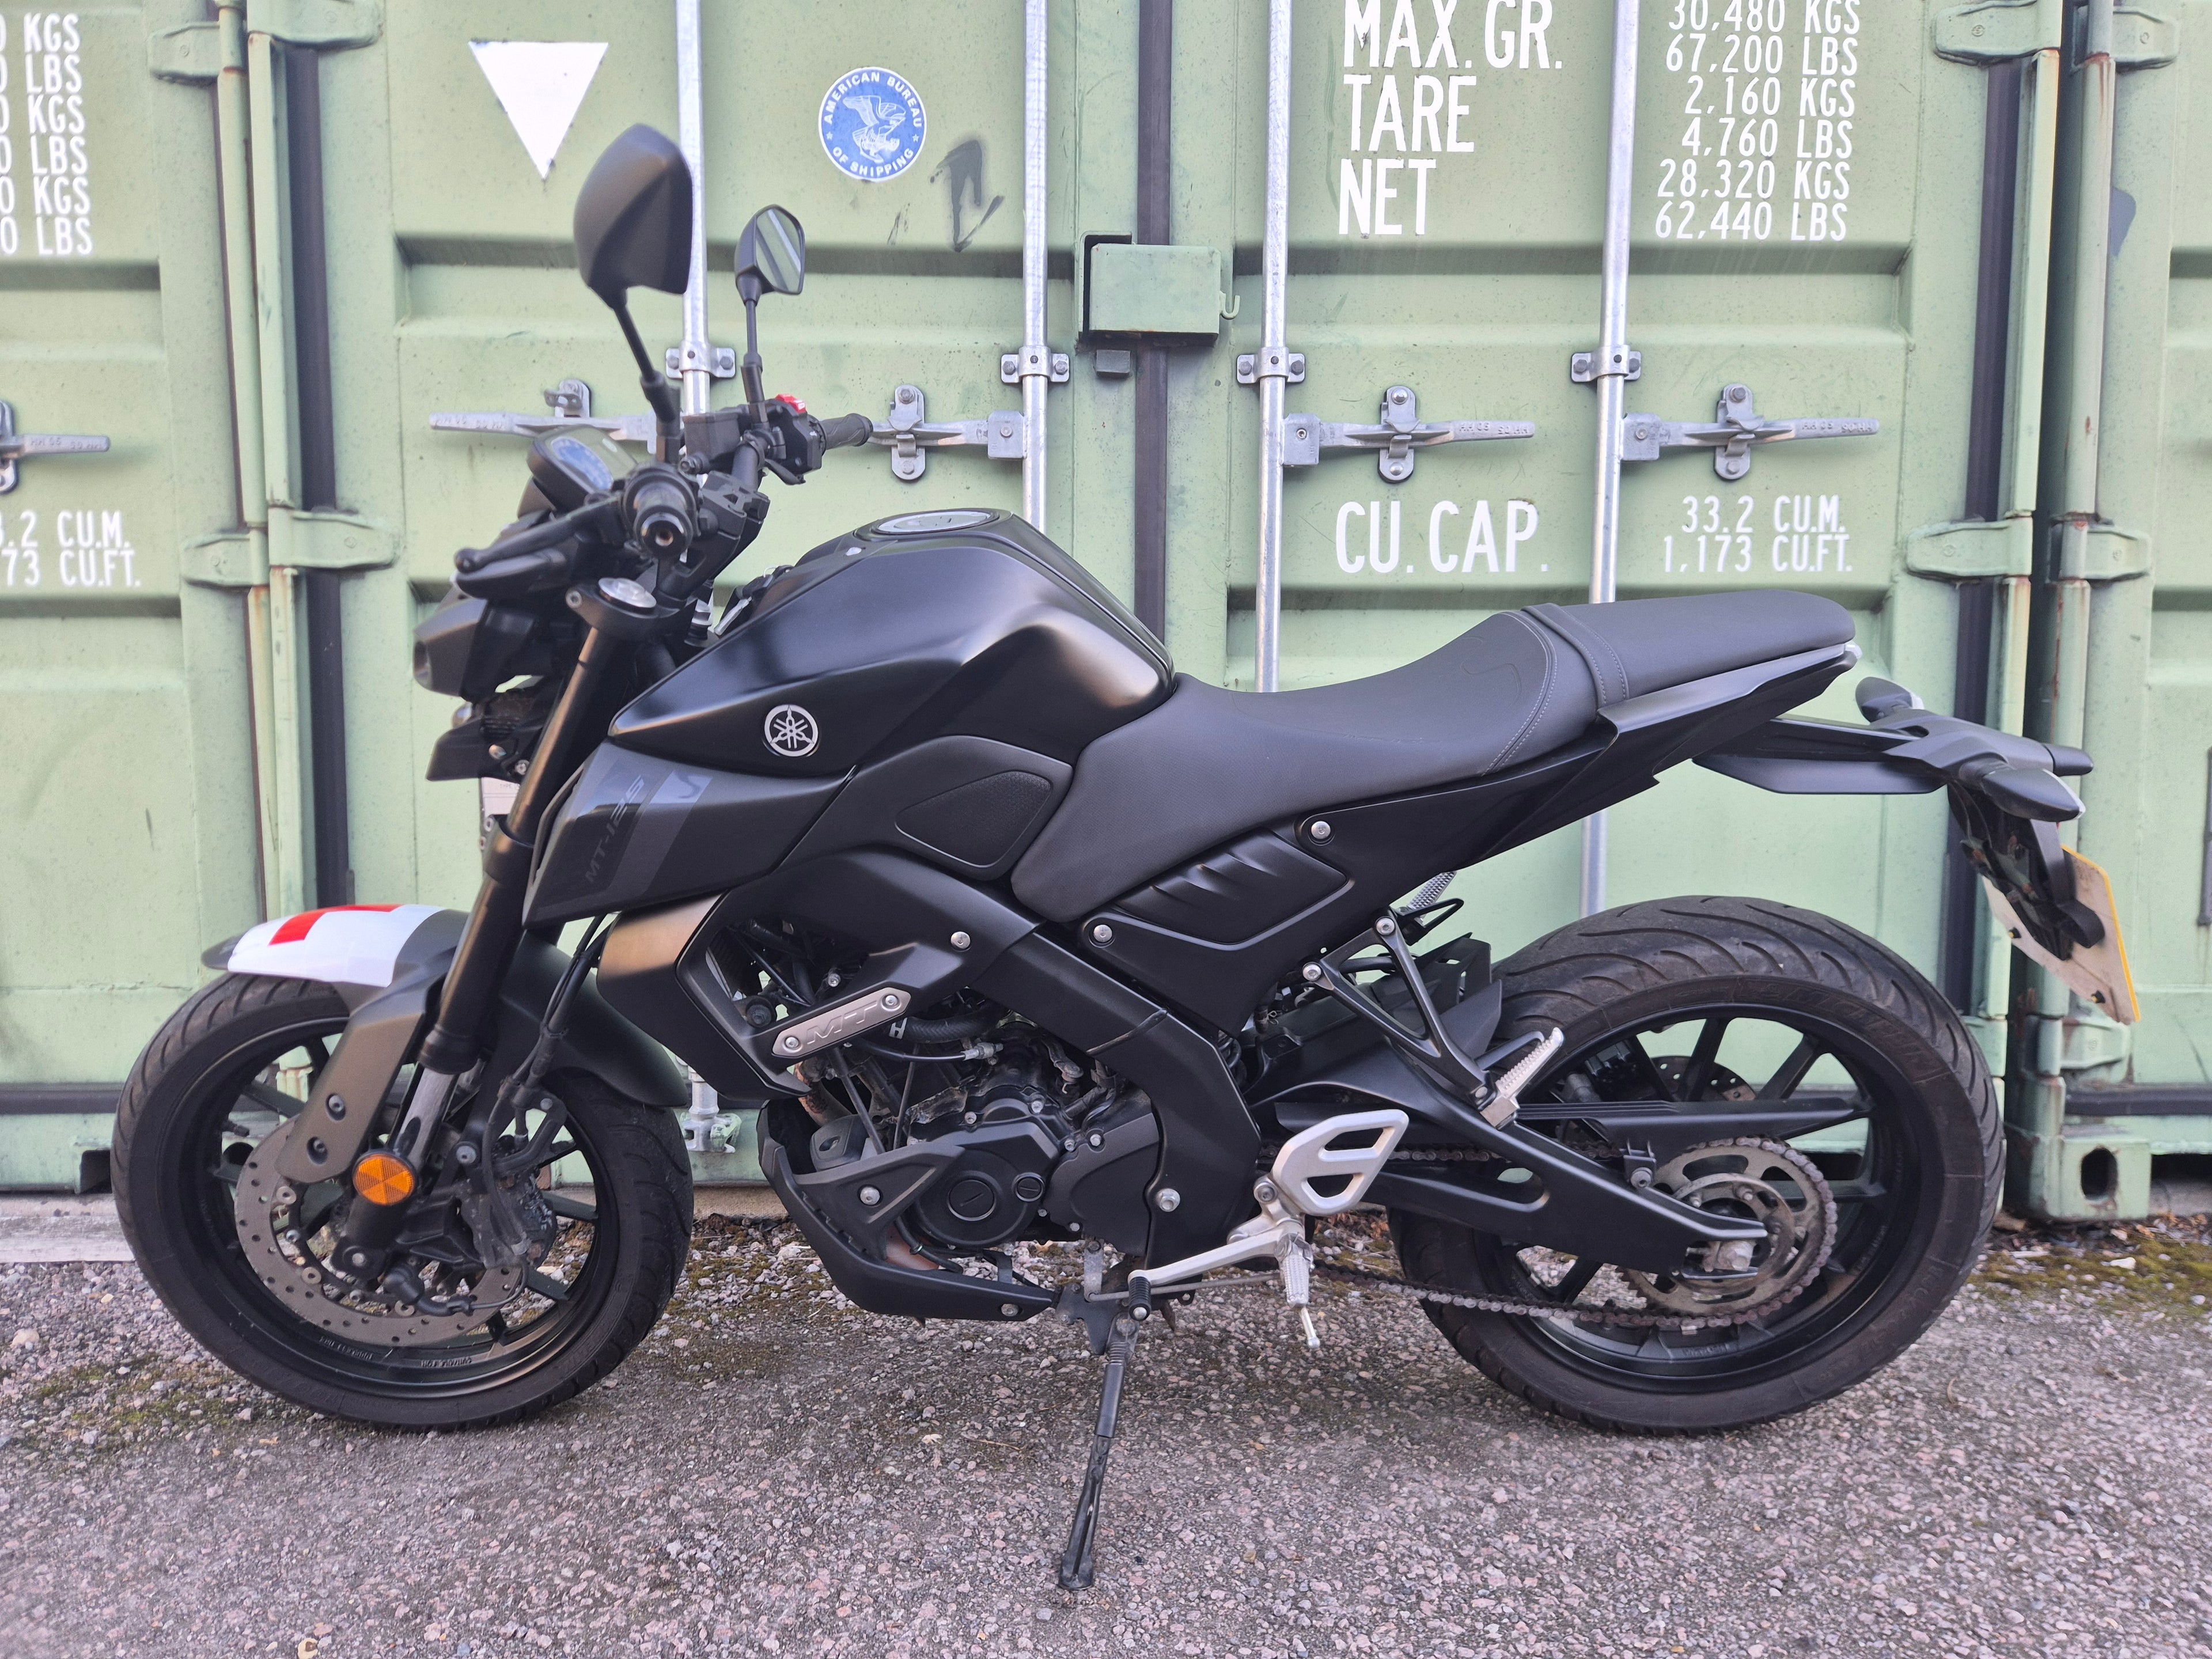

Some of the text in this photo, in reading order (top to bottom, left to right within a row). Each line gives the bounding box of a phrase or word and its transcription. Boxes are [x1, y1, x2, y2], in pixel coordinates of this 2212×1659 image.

[24, 13, 80, 52] KGS
[1669, 0, 1860, 34] 30,480 KGS
[25, 54, 82, 93] LBS
[1666, 33, 1858, 76] 67,200 LBS
[28, 94, 85, 134] KGS
[824, 71, 923, 127] AMERICAN BUREAU
[1344, 74, 1477, 153] TARE
[1685, 75, 1856, 117] 2,160 KGS
[31, 135, 88, 175] LBS
[1682, 117, 1853, 159] 4,760 LBS
[832, 146, 914, 177] OF SHIPPING
[1658, 158, 1850, 200] 28,320 KGS
[33, 176, 90, 215] KGS
[1339, 158, 1437, 235] NET
[36, 217, 92, 255] LBS
[1656, 200, 1848, 241] 62,440 LBS
[0, 510, 131, 548] .2 CU.M.
[1681, 494, 1846, 533] 33.2 CU.M.
[59, 548, 142, 586] CU.FT.
[1664, 534, 1853, 574] 1,173 CU.FT.
[806, 999, 878, 1045] MT
